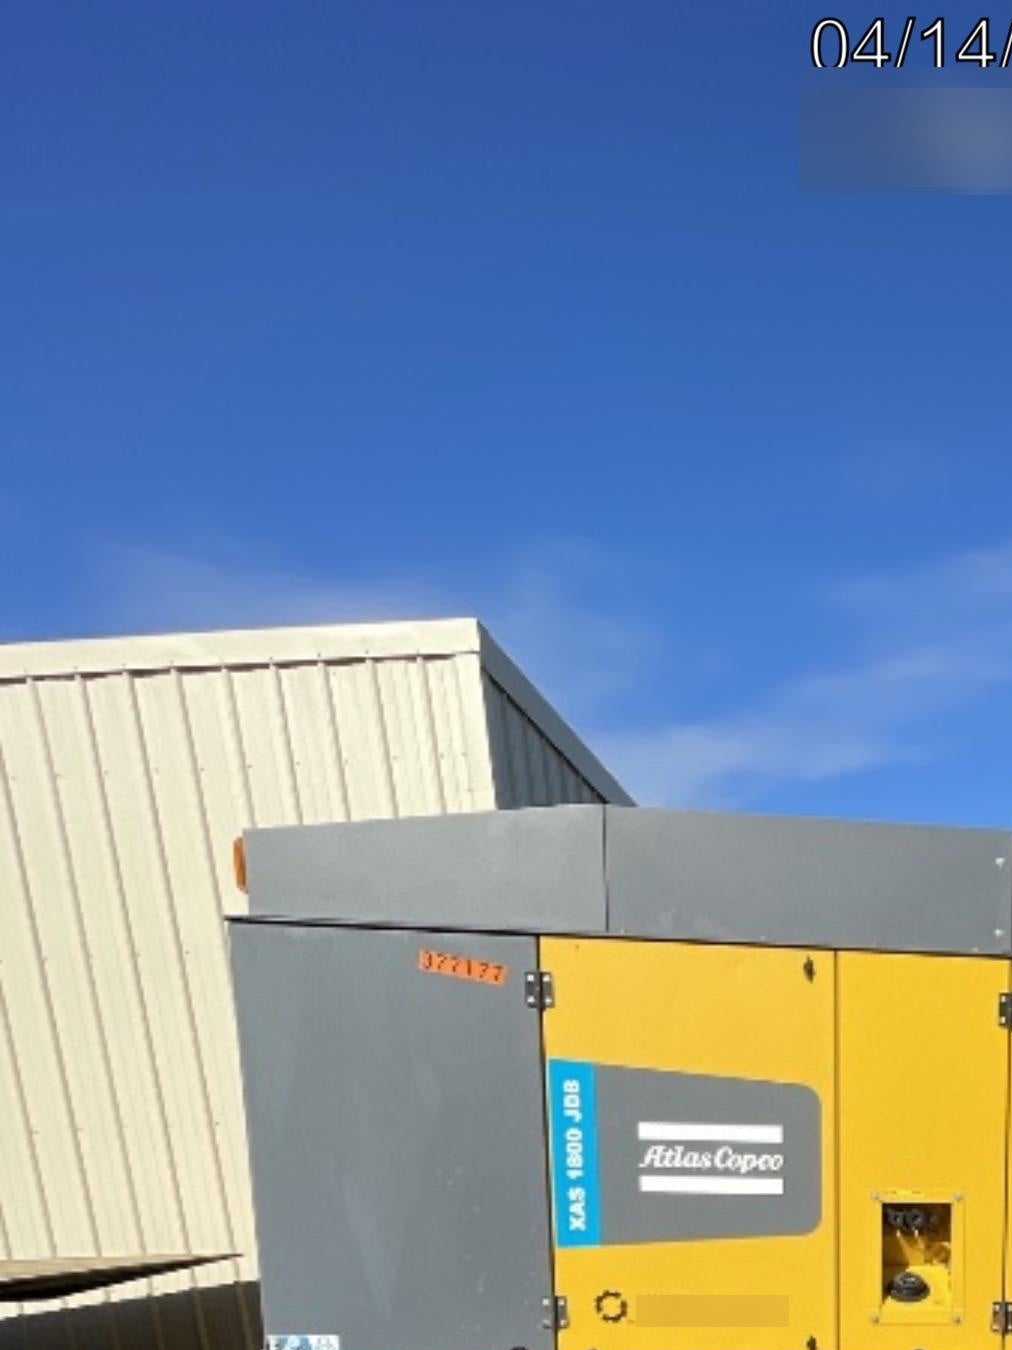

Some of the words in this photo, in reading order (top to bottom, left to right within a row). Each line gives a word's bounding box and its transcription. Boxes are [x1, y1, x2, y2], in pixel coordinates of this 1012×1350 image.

[565, 1127, 584, 1180] 1800
[638, 1145, 711, 1169] Atlas
[713, 1146, 784, 1174] Copco
[568, 1187, 586, 1232] XAS
